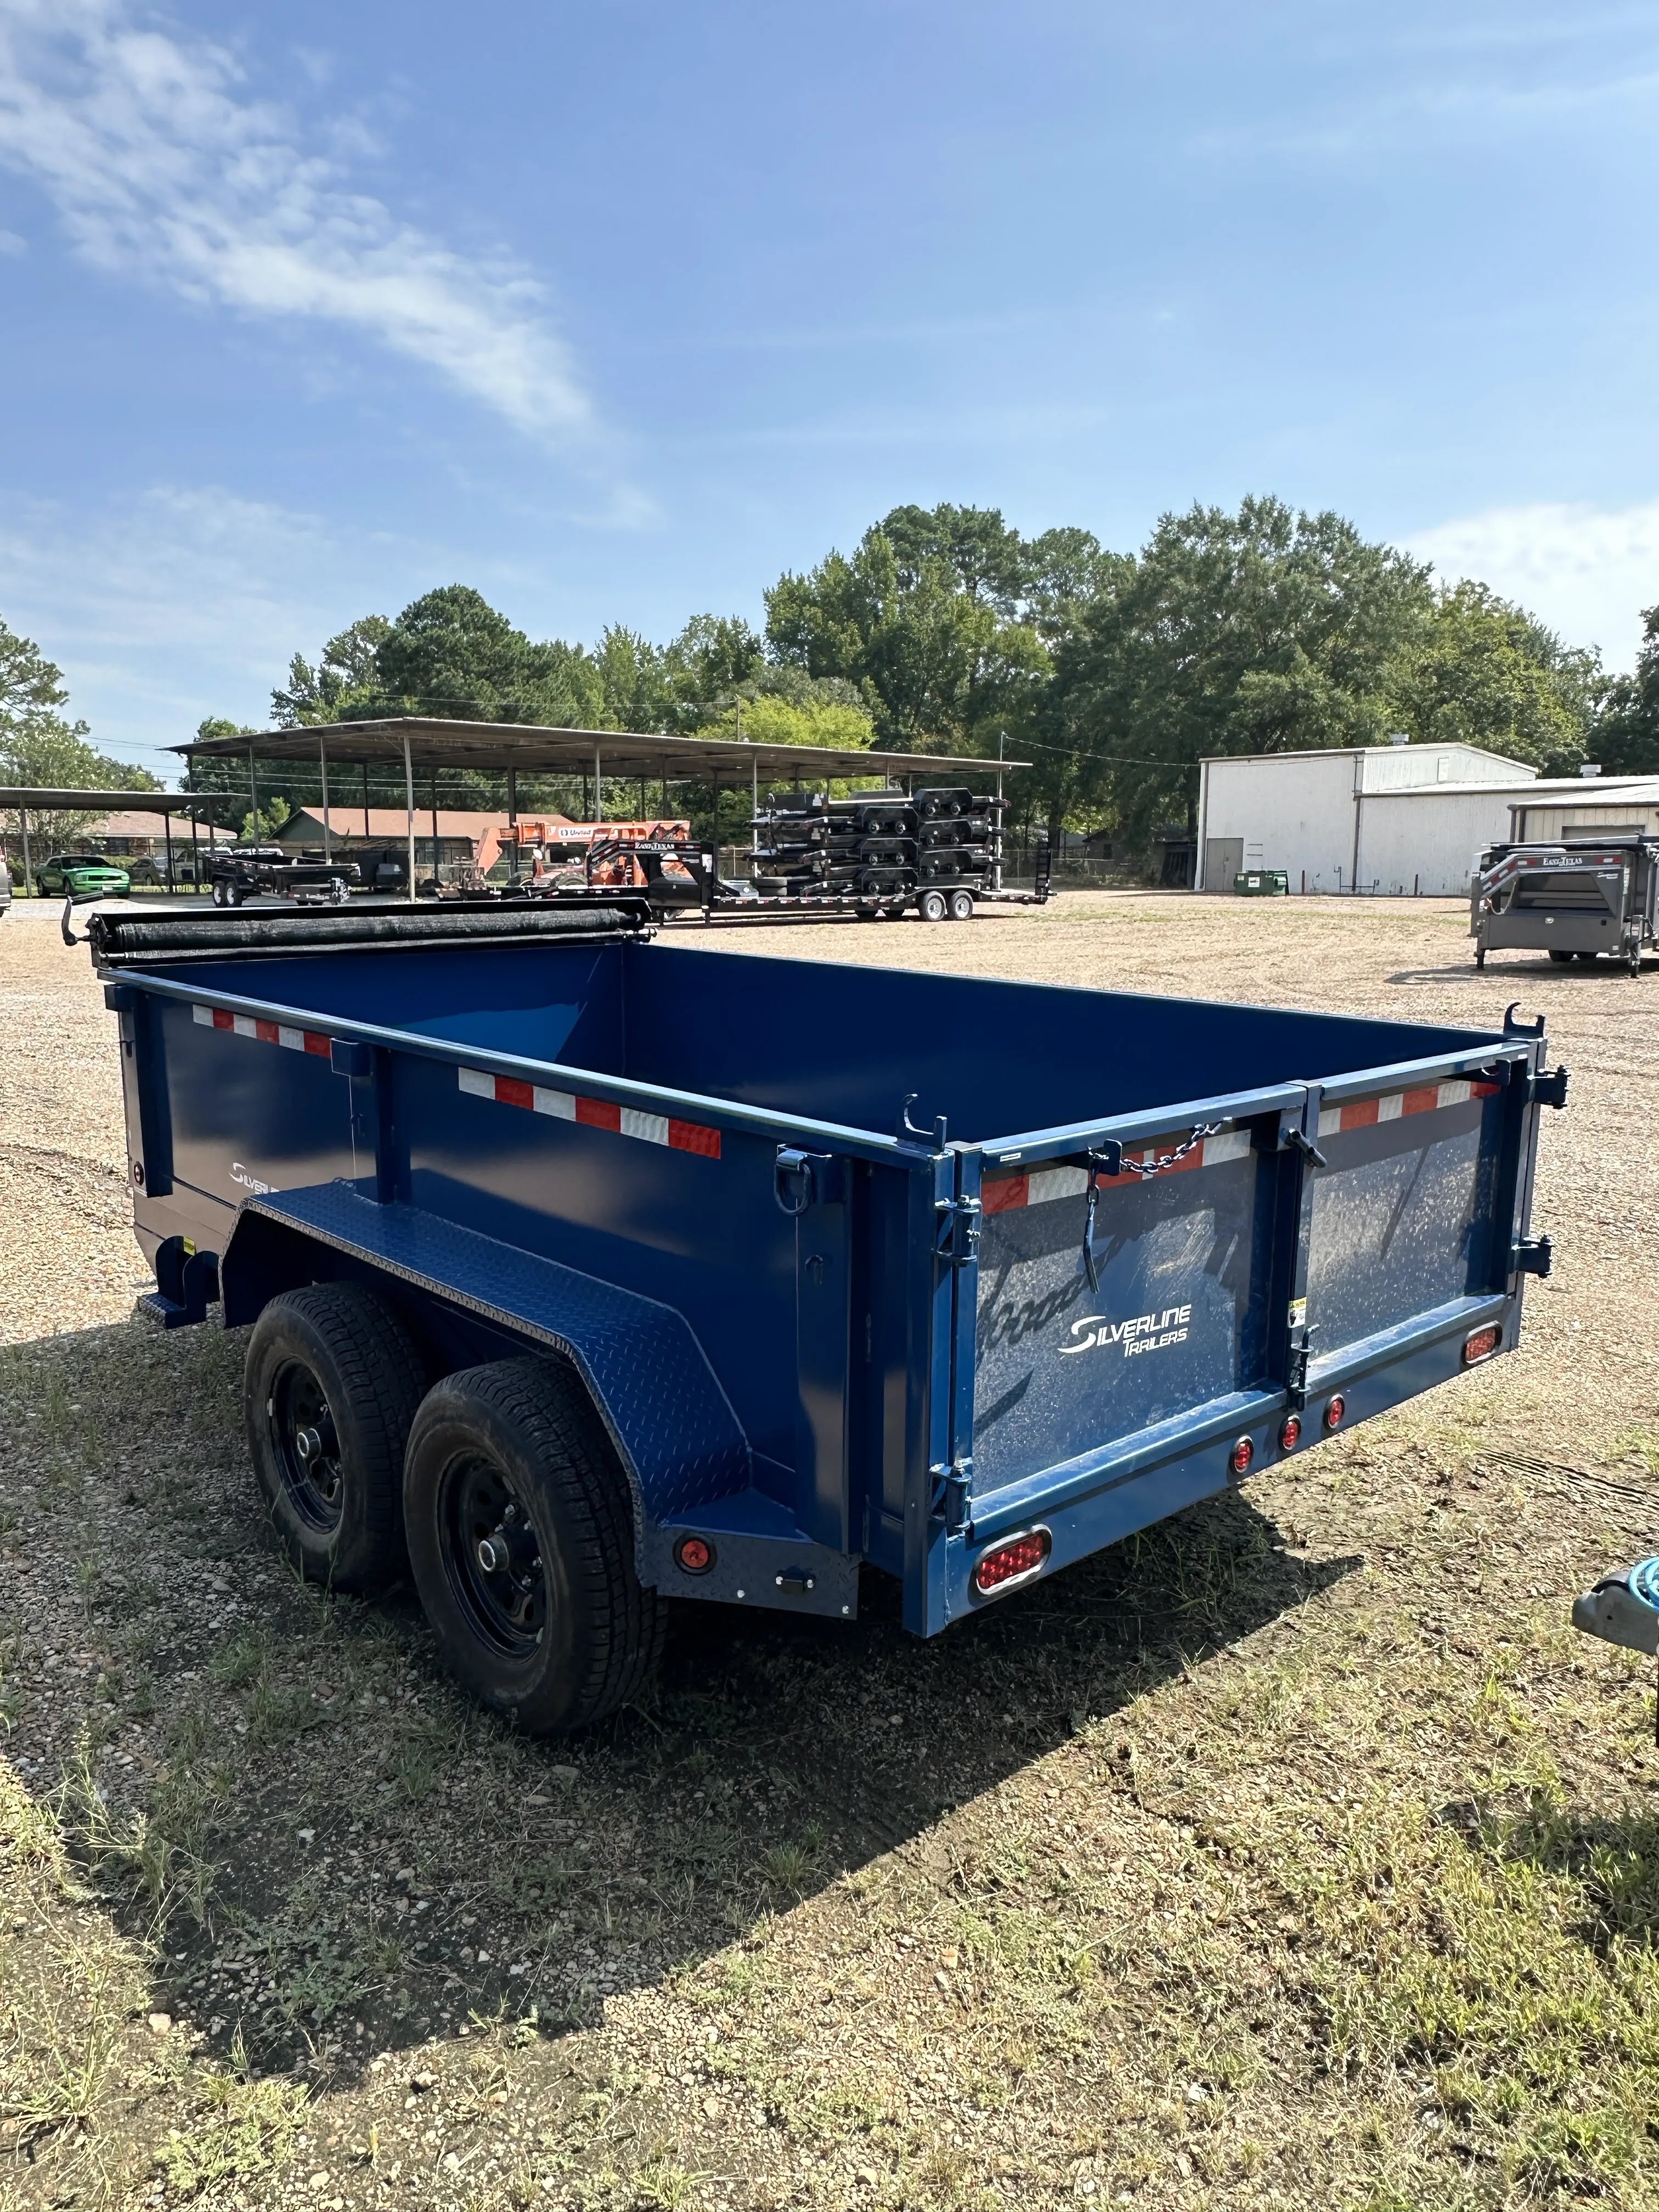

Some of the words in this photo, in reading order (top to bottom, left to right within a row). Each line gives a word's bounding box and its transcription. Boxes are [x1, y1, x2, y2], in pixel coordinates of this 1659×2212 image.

[229, 1163, 280, 1195] SILVER
[1057, 1304, 1192, 1353] SILVERLINE
[1122, 1328, 1188, 1357] TRAILERS
